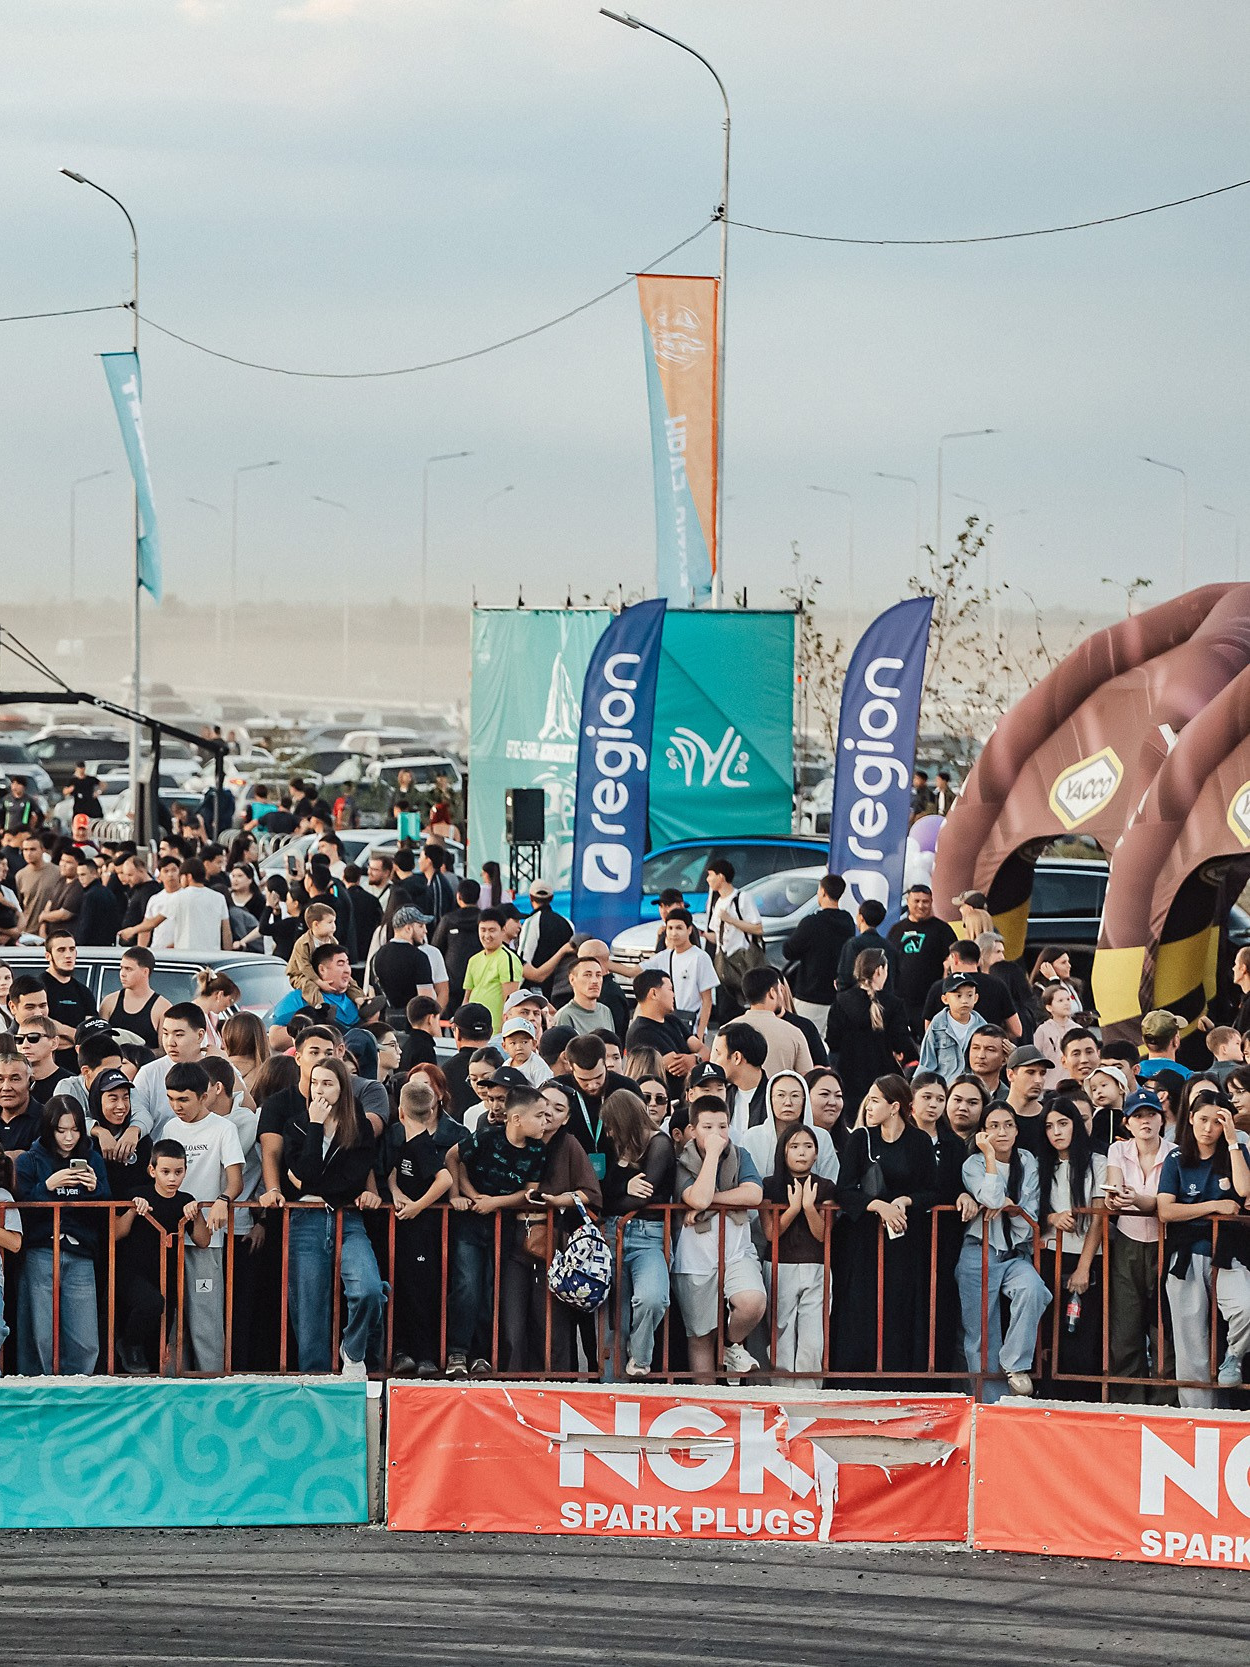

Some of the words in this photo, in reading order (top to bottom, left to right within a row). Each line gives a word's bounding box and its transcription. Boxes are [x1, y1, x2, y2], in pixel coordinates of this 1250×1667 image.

[585, 652, 648, 836] region
[843, 656, 910, 862] region
[1065, 776, 1114, 800] YACCO
[558, 1399, 818, 1495] NGK
[560, 1501, 682, 1532] SPARK
[691, 1504, 816, 1536] PLUGS
